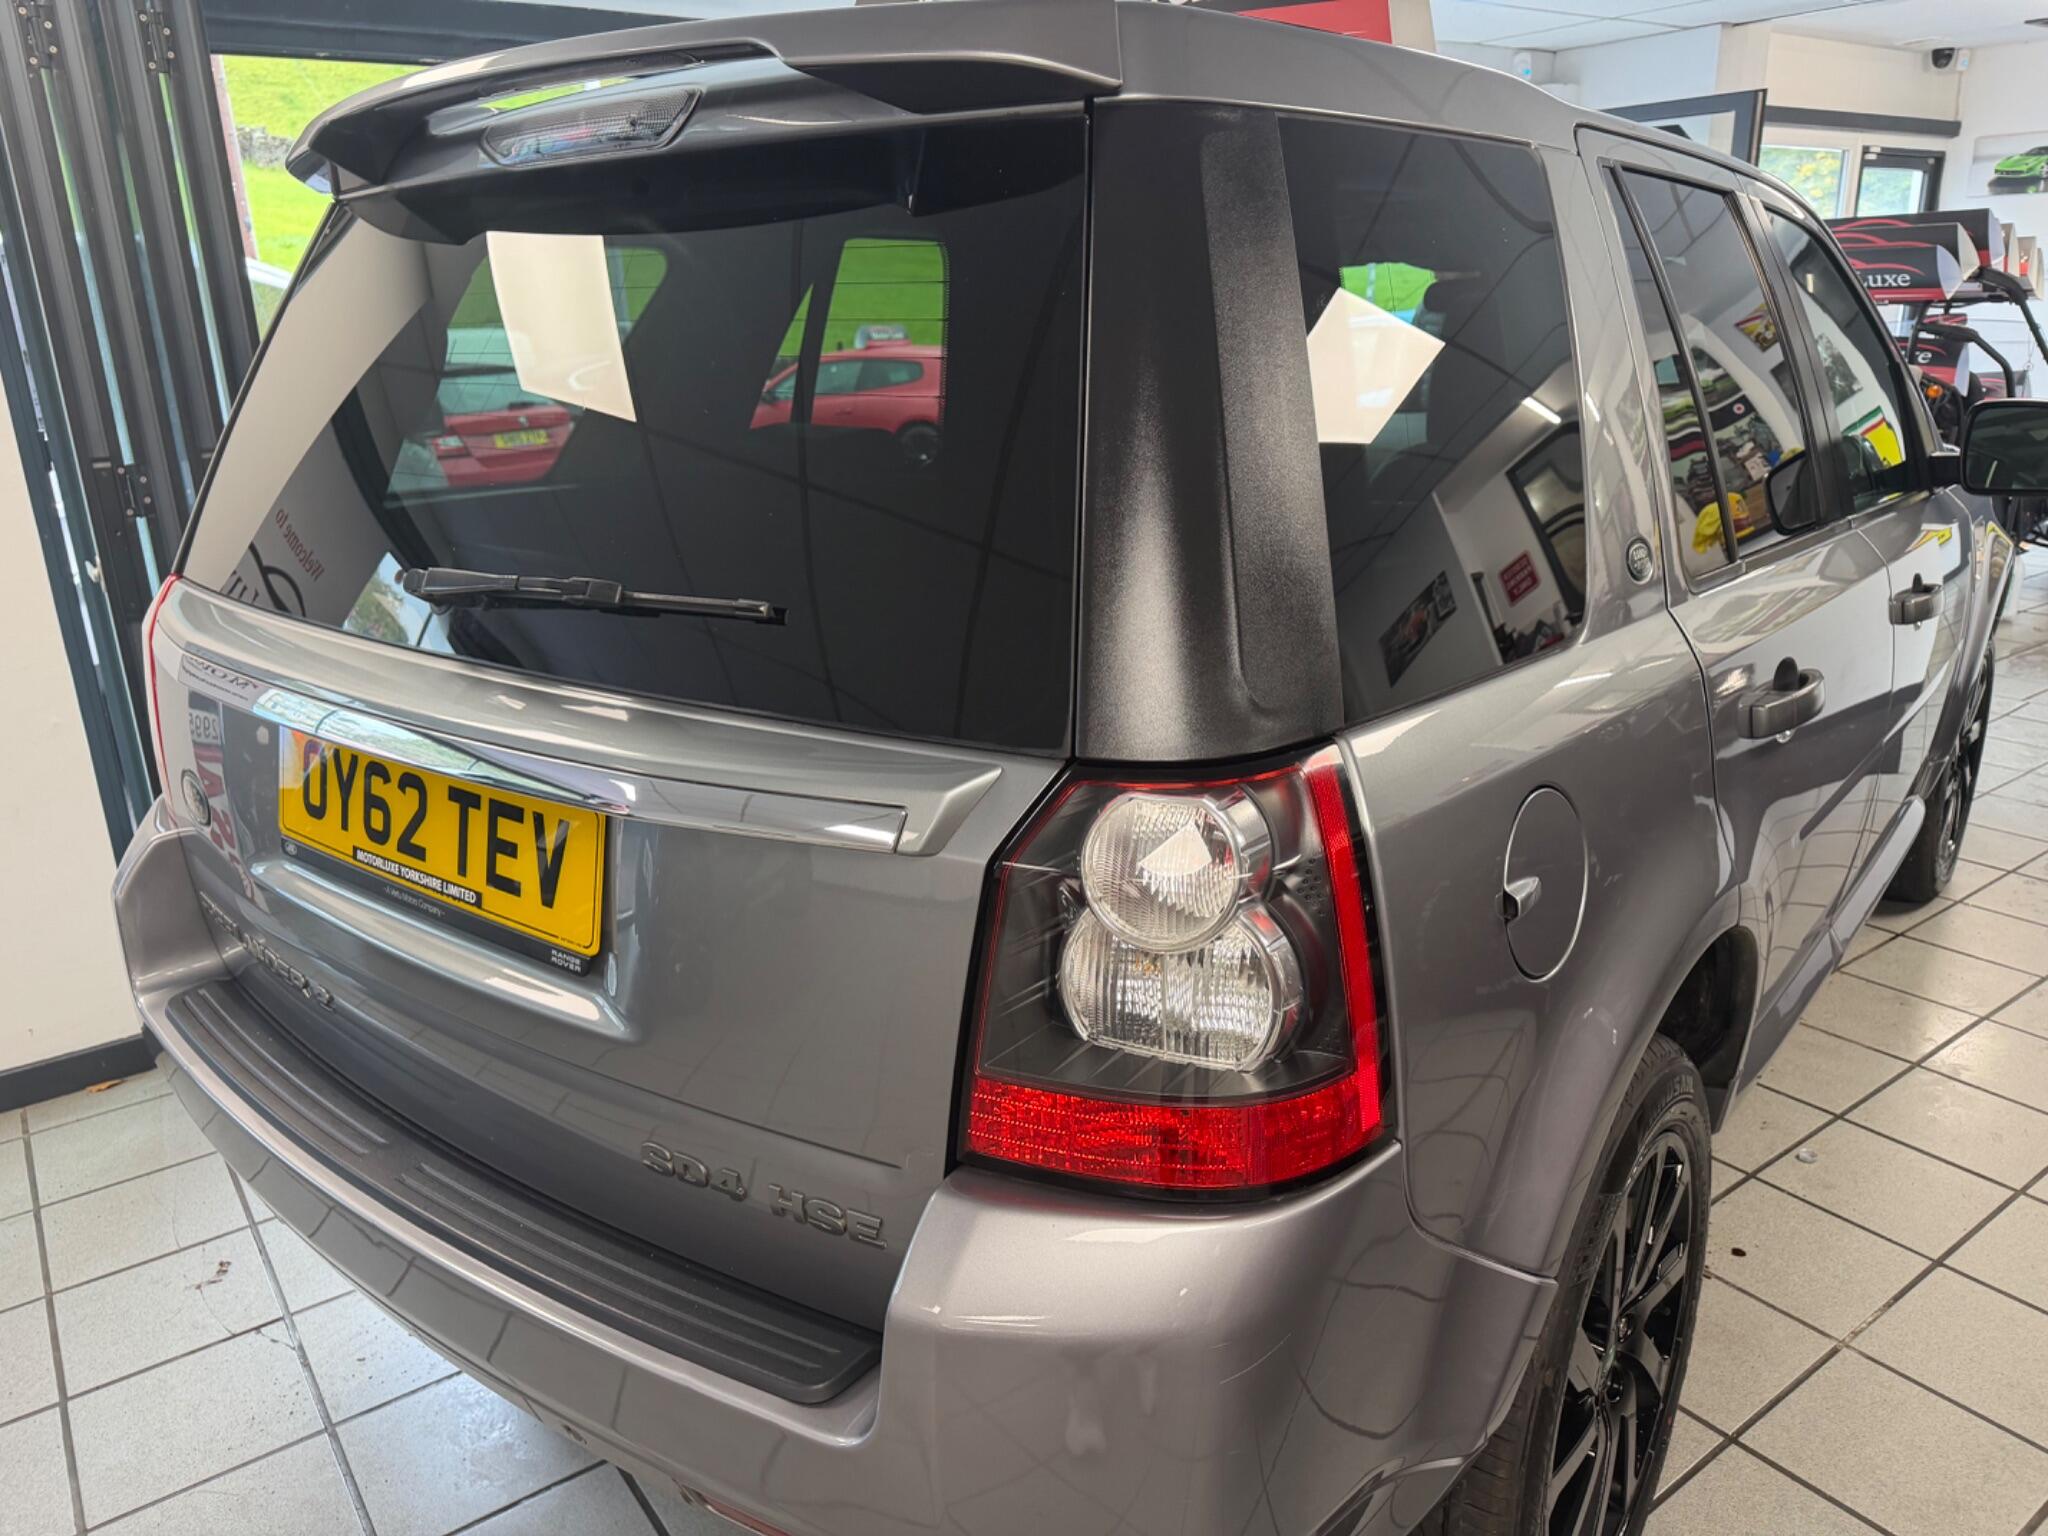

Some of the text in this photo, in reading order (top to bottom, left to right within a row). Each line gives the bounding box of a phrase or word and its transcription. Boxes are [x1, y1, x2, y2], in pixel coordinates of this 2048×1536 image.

[303, 739, 429, 863] OY62
[448, 785, 571, 909] TEV
[356, 849, 400, 876] MOTORLUXE
[400, 866, 442, 891] YORKSHIRE
[443, 882, 476, 904] LIMITED
[551, 949, 581, 965] RANGE
[551, 956, 581, 973] ROVER
[641, 1141, 887, 1249] SD4 HSE
